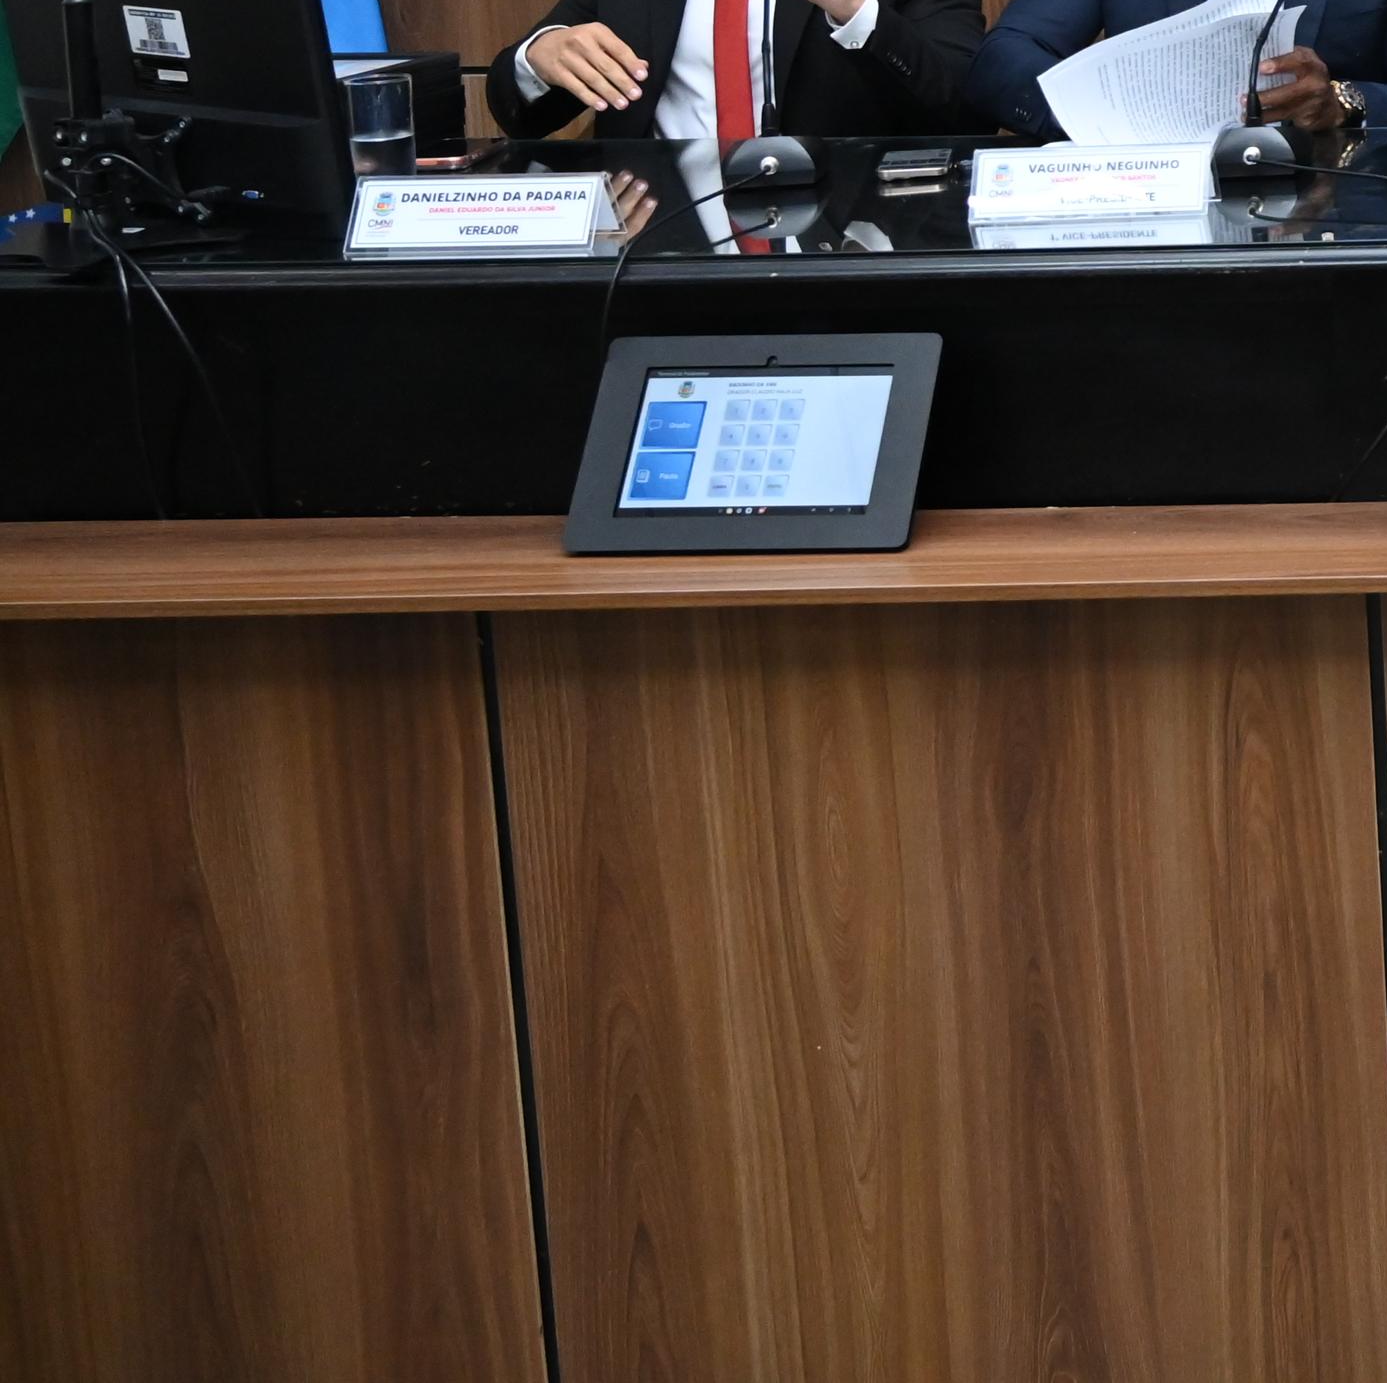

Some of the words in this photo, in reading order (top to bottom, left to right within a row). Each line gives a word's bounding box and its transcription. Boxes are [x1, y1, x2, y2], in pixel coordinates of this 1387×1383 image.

[1106, 159, 1180, 171] NEGUINHO
[401, 191, 498, 203] DANIELZINHO
[502, 191, 522, 202] DA
[526, 190, 587, 201] PADARIA
[458, 224, 519, 236] VEREADOR
